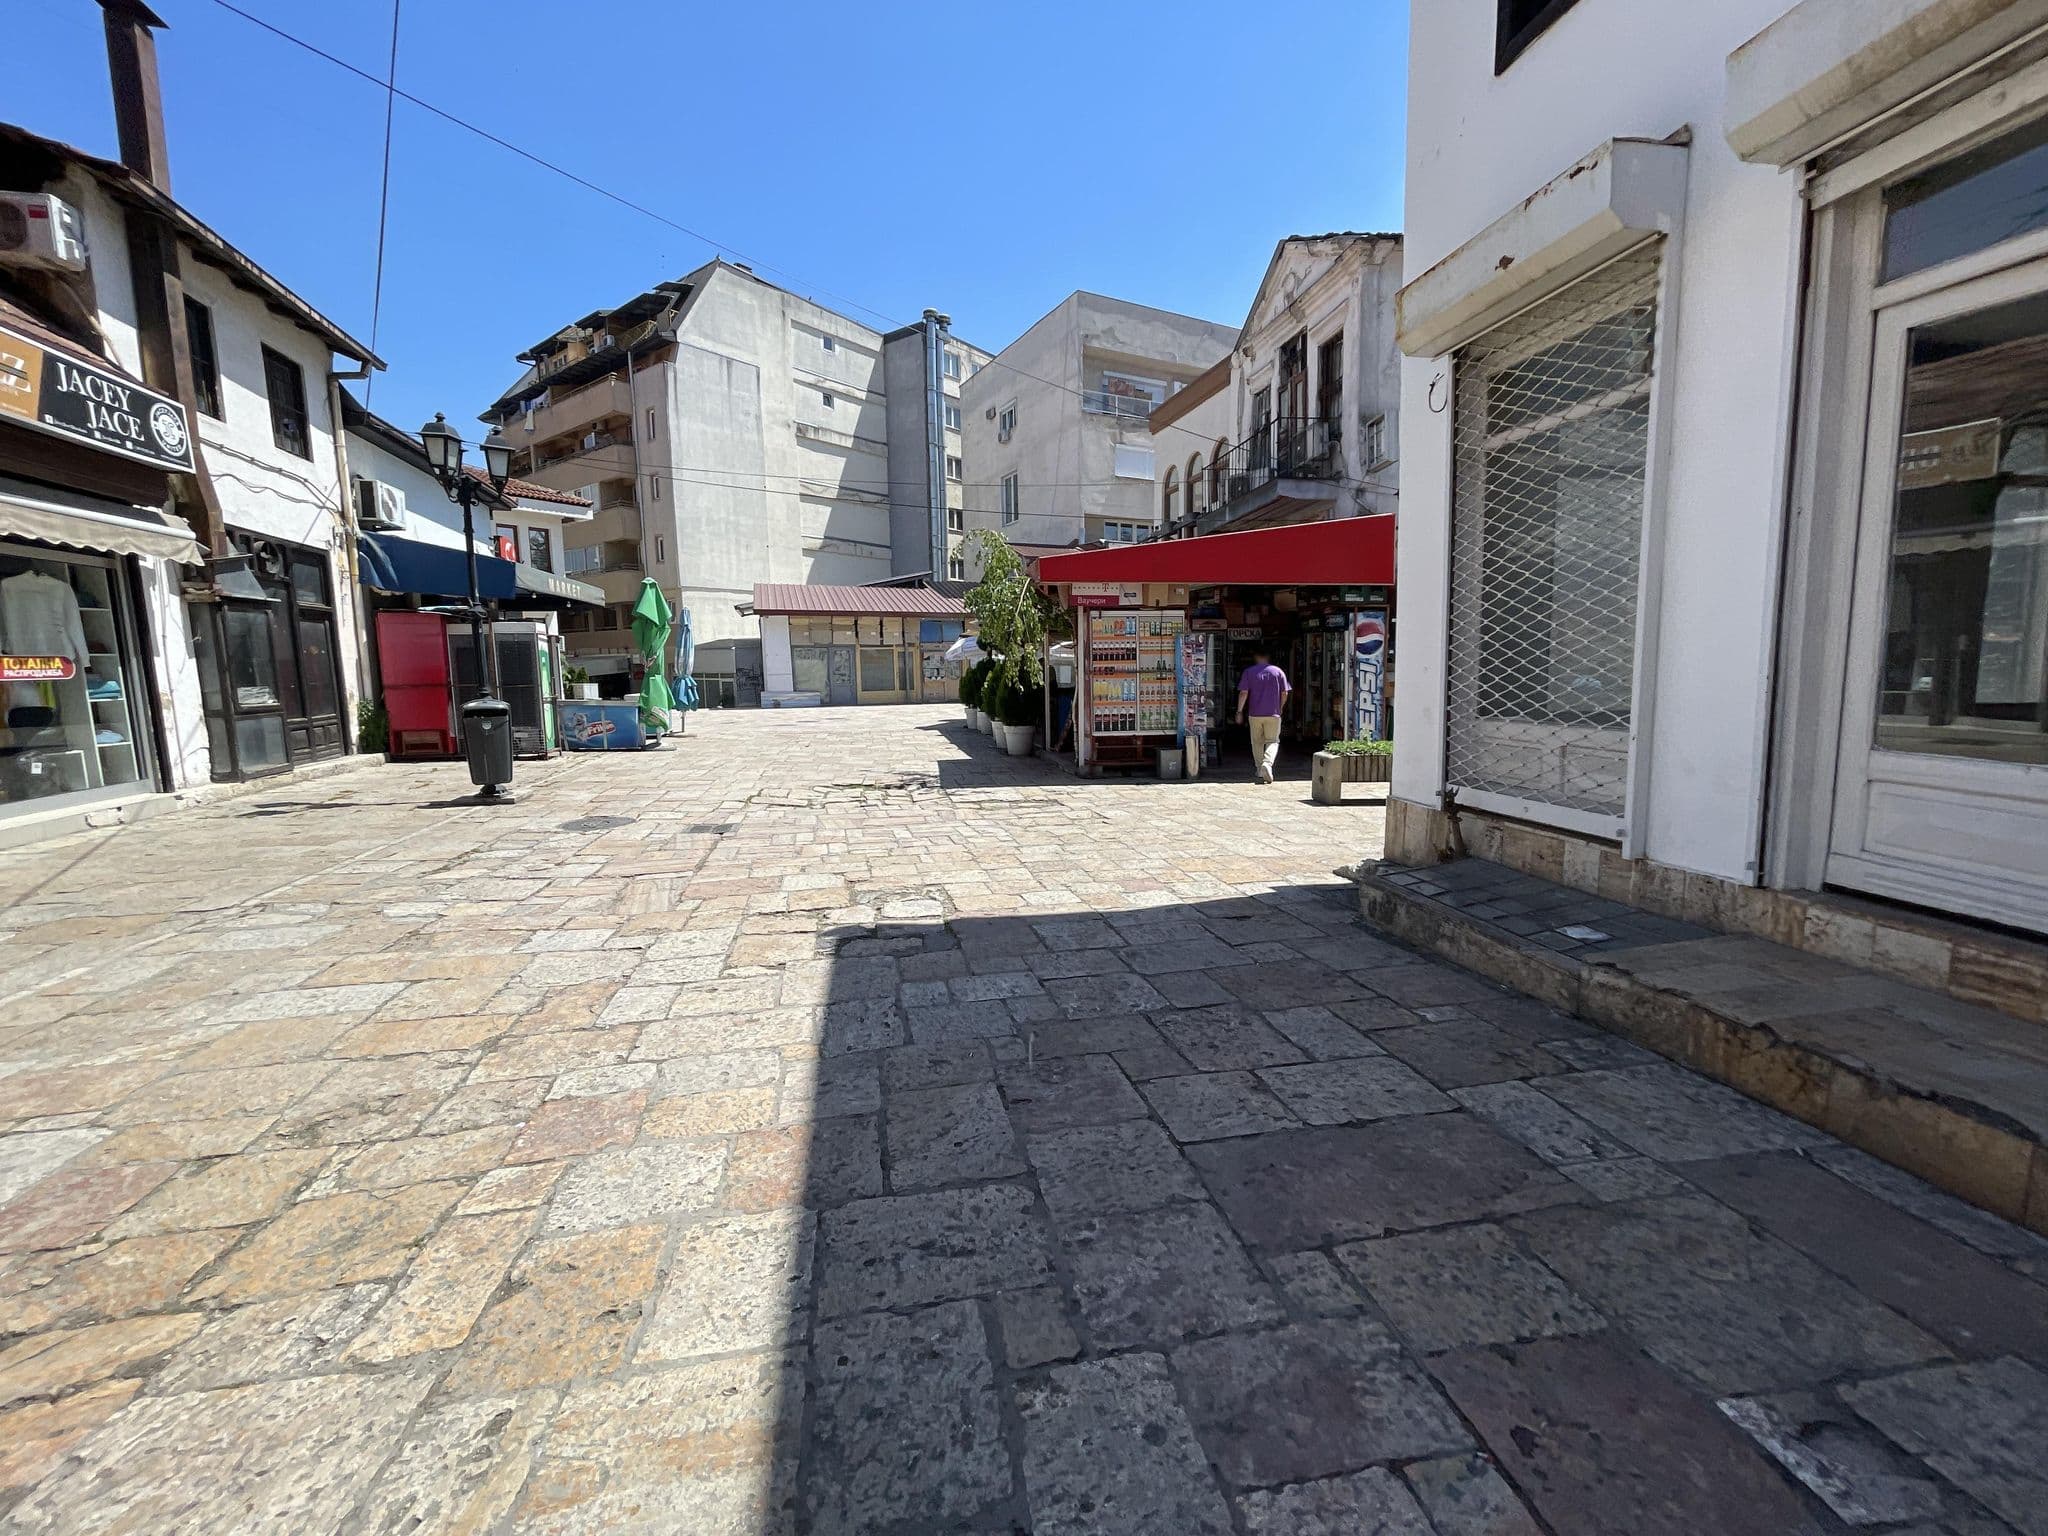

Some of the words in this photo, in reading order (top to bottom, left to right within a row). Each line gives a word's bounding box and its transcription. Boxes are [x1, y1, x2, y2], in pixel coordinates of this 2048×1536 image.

[56, 362, 131, 412] JACEY
[86, 400, 145, 442] JACE
[549, 578, 581, 598] MARKET
[1077, 597, 1106, 605] Ваучери
[3, 657, 63, 669] ТОТАЛНА
